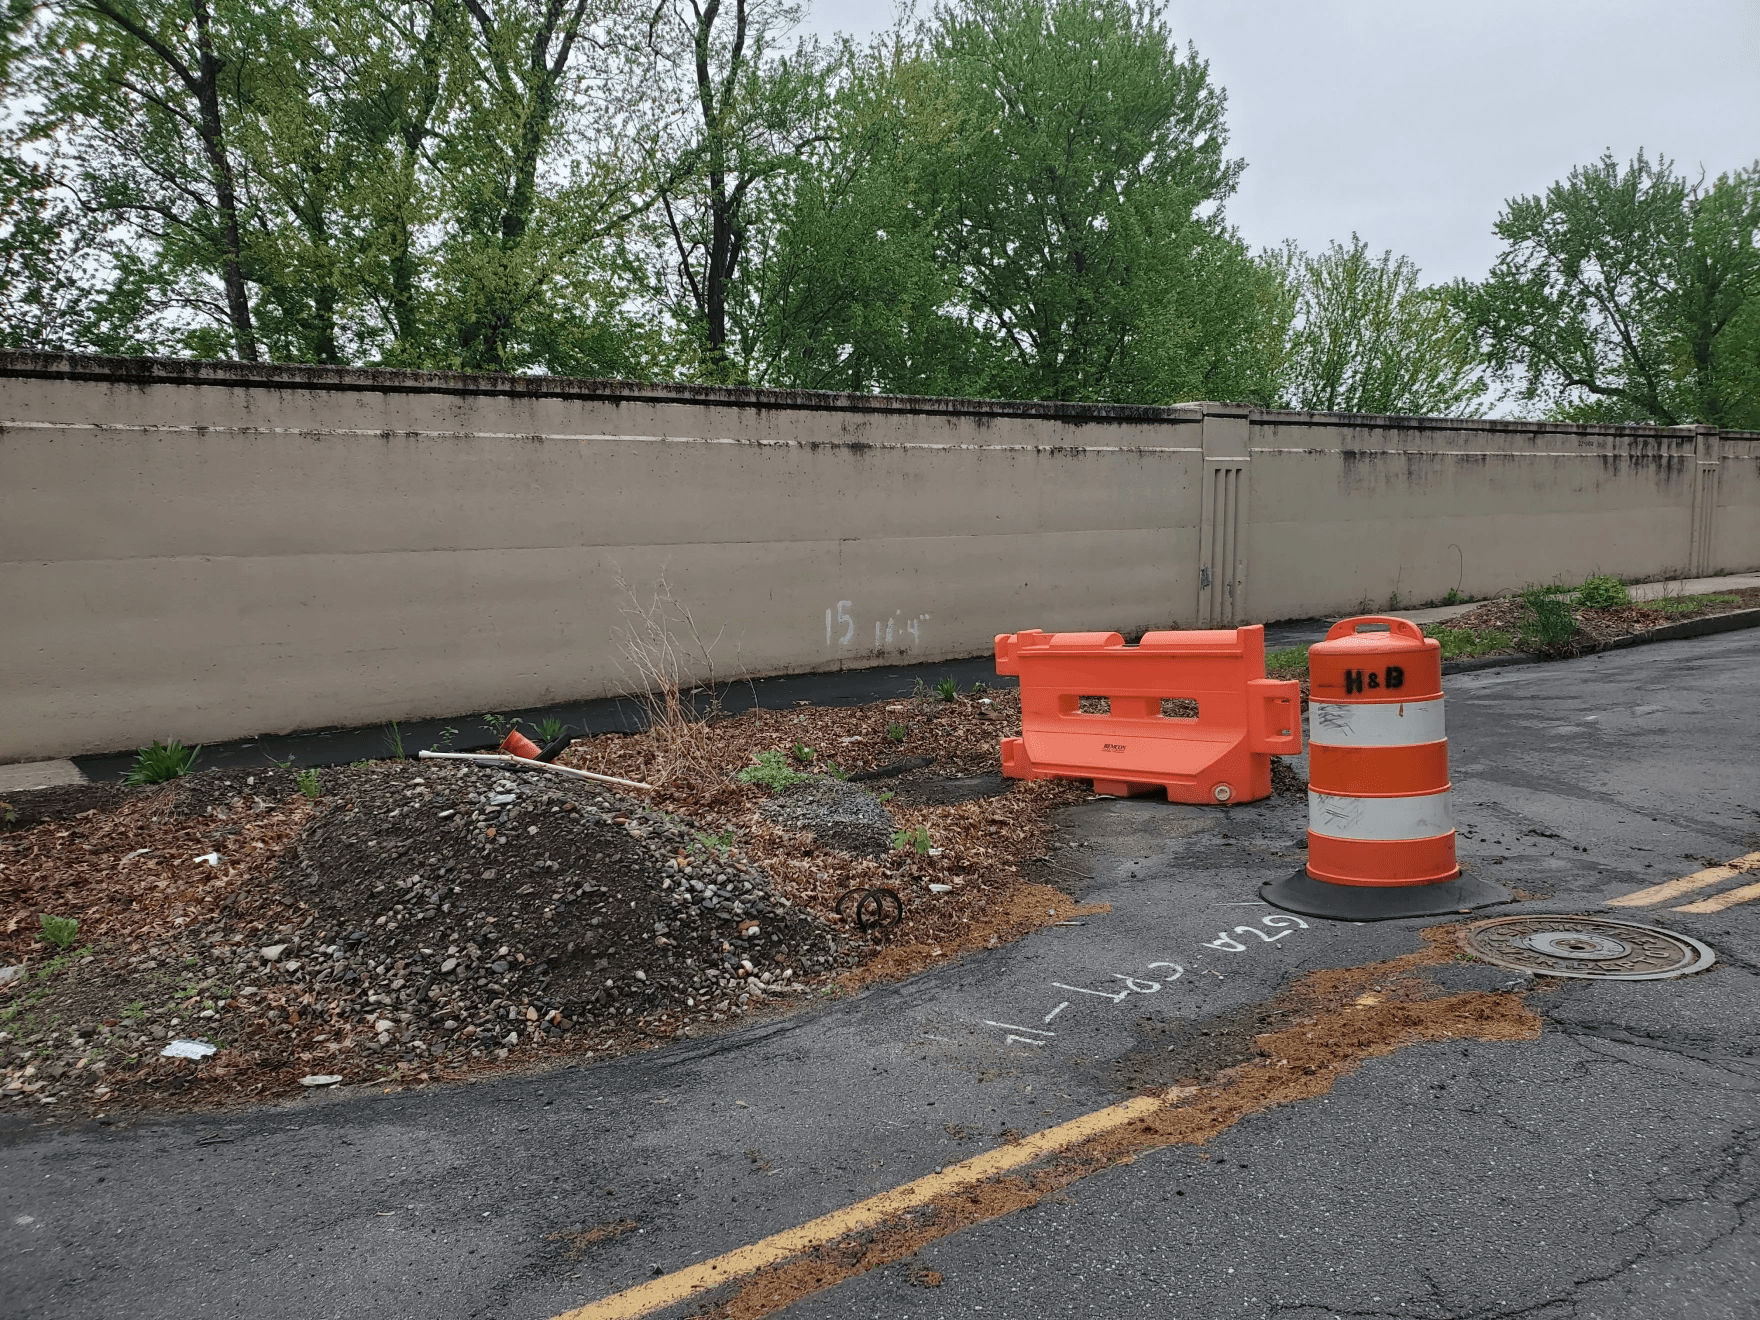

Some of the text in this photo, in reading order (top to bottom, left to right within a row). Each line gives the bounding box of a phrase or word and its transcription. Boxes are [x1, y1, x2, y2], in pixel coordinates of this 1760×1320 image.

[825, 600, 854, 645] 15
[1345, 669, 1363, 694] H
[1368, 672, 1380, 689] &
